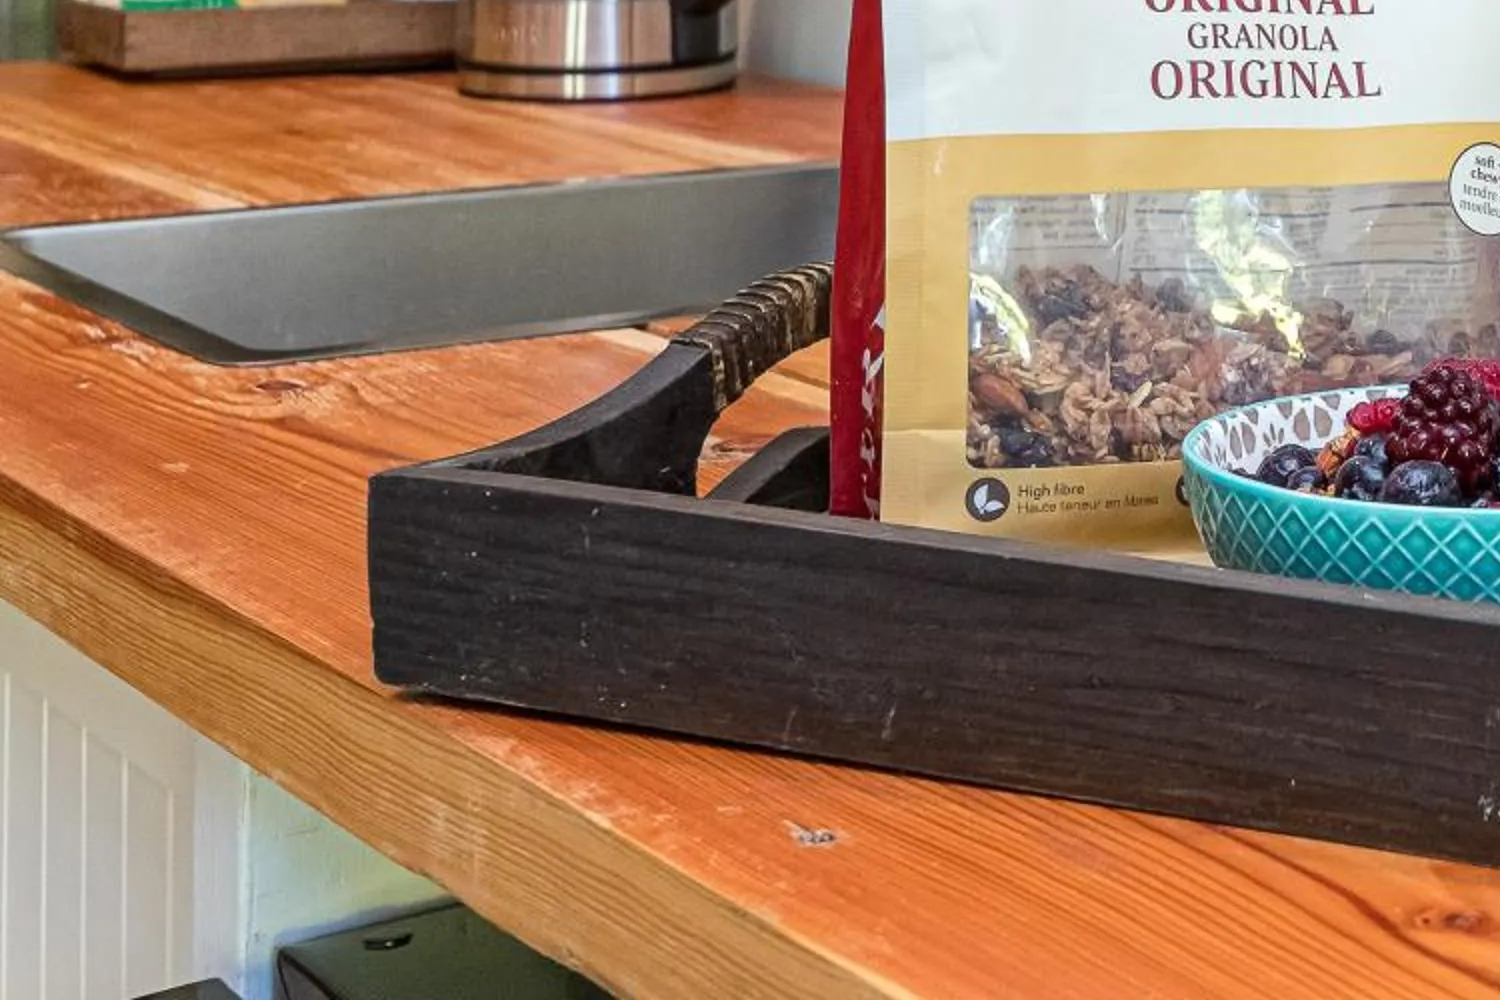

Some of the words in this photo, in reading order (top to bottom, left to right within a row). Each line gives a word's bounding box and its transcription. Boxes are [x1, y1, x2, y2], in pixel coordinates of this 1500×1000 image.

[1187, 22, 1339, 52] GRANOLA
[1151, 59, 1382, 100] ORIGINAL
[1475, 154, 1495, 169] soft
[1018, 484, 1051, 500] High
